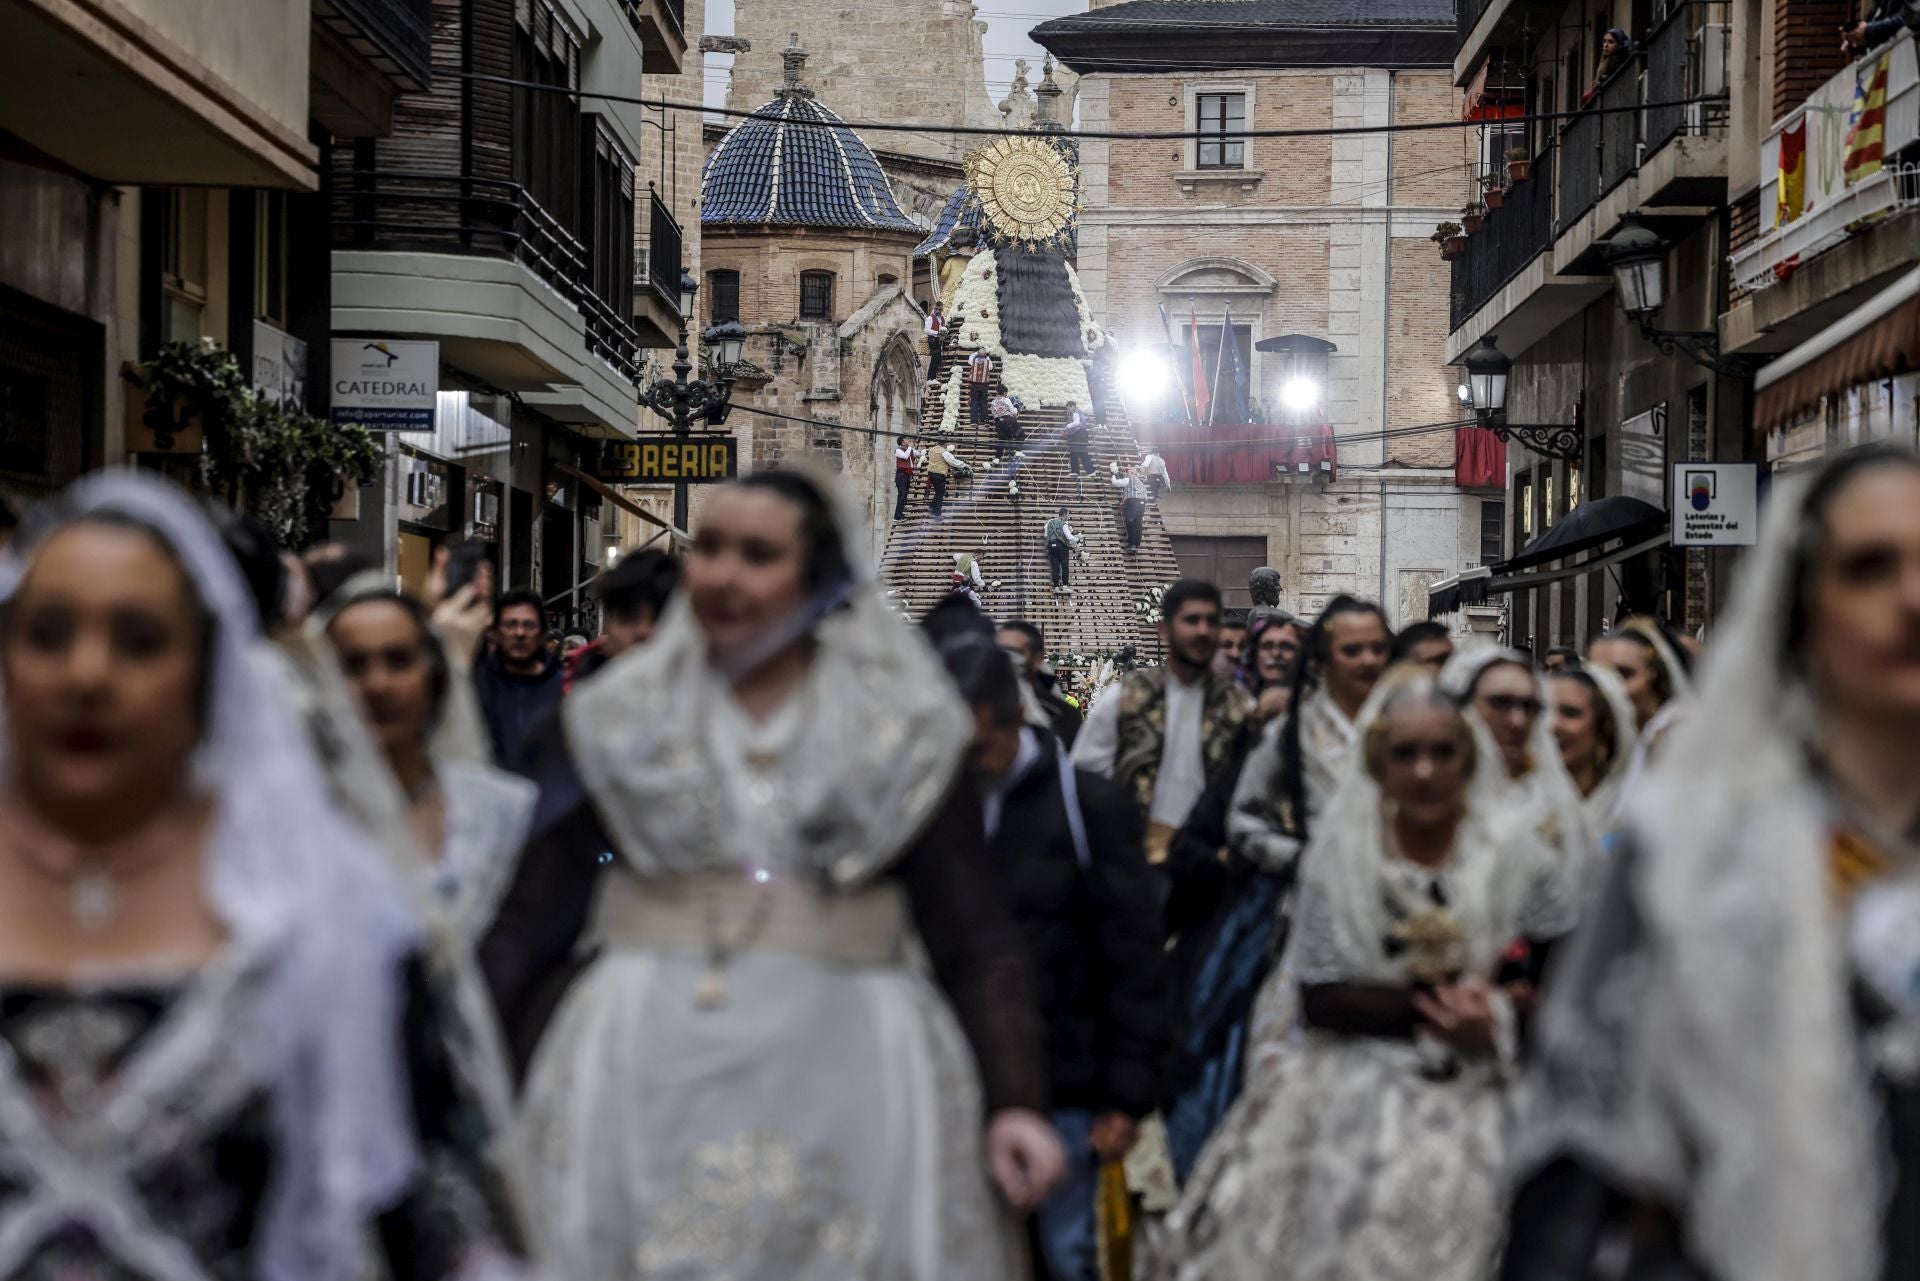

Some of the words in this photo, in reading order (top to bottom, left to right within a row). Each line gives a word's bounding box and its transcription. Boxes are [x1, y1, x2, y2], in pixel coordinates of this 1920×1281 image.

[336, 381, 430, 396] CATEDRAL
[1720, 514, 1726, 522] y
[1685, 522, 1723, 531] Apuestas
[1725, 521, 1738, 530] del
[1685, 531, 1713, 540] Estado
